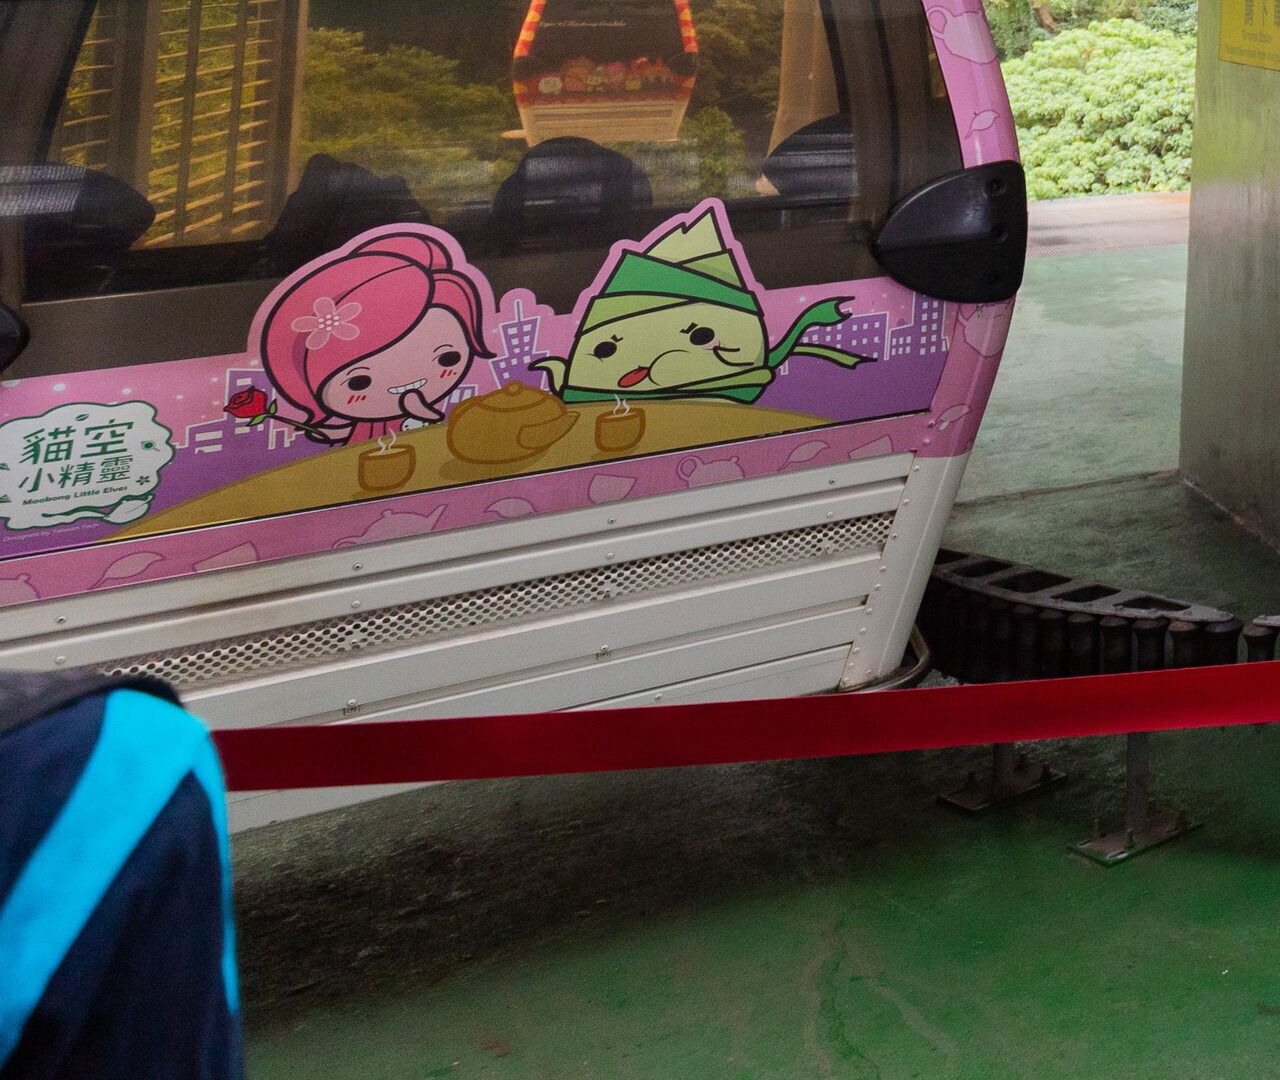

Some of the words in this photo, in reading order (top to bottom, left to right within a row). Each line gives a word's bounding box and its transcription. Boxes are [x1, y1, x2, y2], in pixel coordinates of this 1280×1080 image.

[18, 419, 135, 465] 貓空
[18, 455, 134, 493] 小精靈
[22, 493, 71, 506] Maokong
[74, 488, 101, 499] Little
[103, 485, 128, 495] Elves
